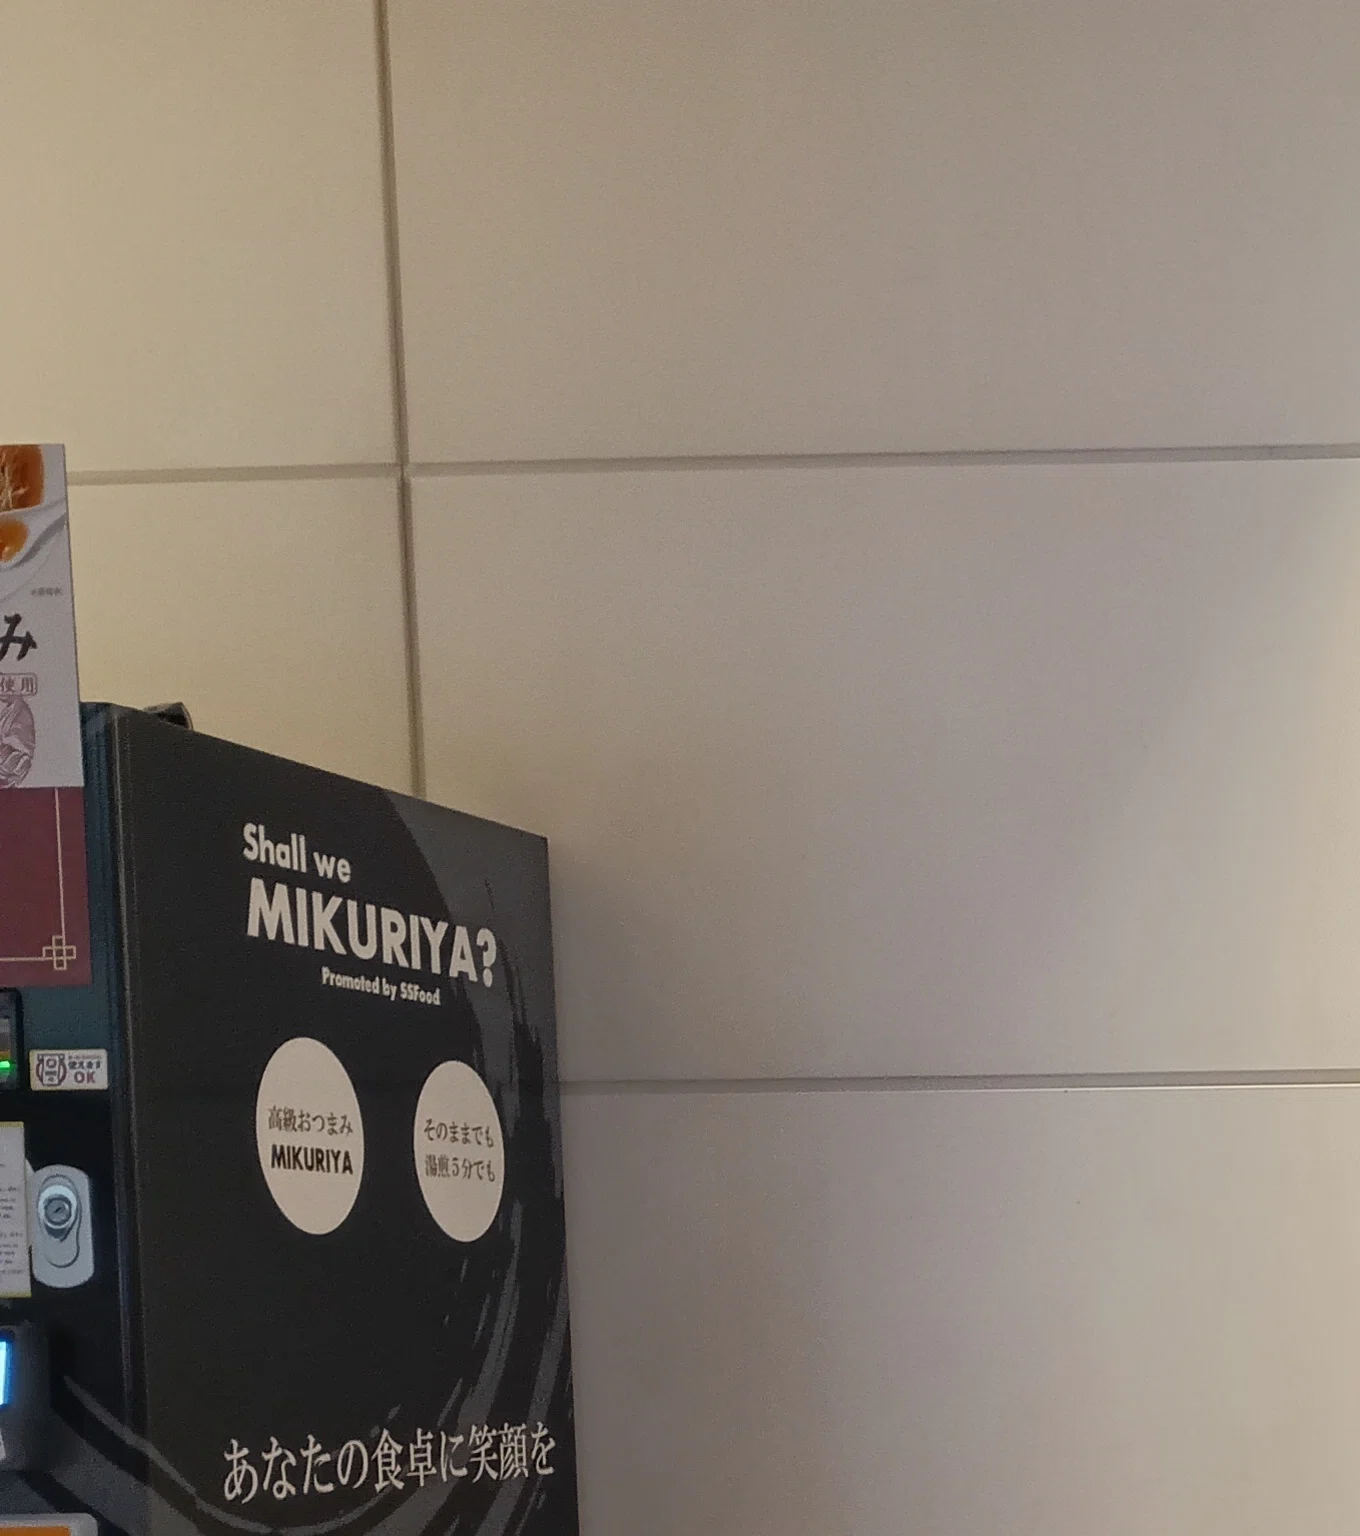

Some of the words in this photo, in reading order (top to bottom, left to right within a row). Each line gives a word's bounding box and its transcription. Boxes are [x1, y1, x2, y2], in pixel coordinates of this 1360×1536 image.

[243, 823, 307, 873] Shall
[313, 851, 351, 883] we
[247, 877, 497, 988] MIKURIYA?
[321, 966, 380, 995] Promoted
[382, 977, 397, 1001] by
[74, 1071, 96, 1083] OK
[268, 1105, 353, 1136] 高級おつまみ
[424, 1118, 494, 1148] そのままでも
[271, 1144, 353, 1175] MIKURIYA
[224, 1421, 556, 1504] あなたの食卓に笑顔を
